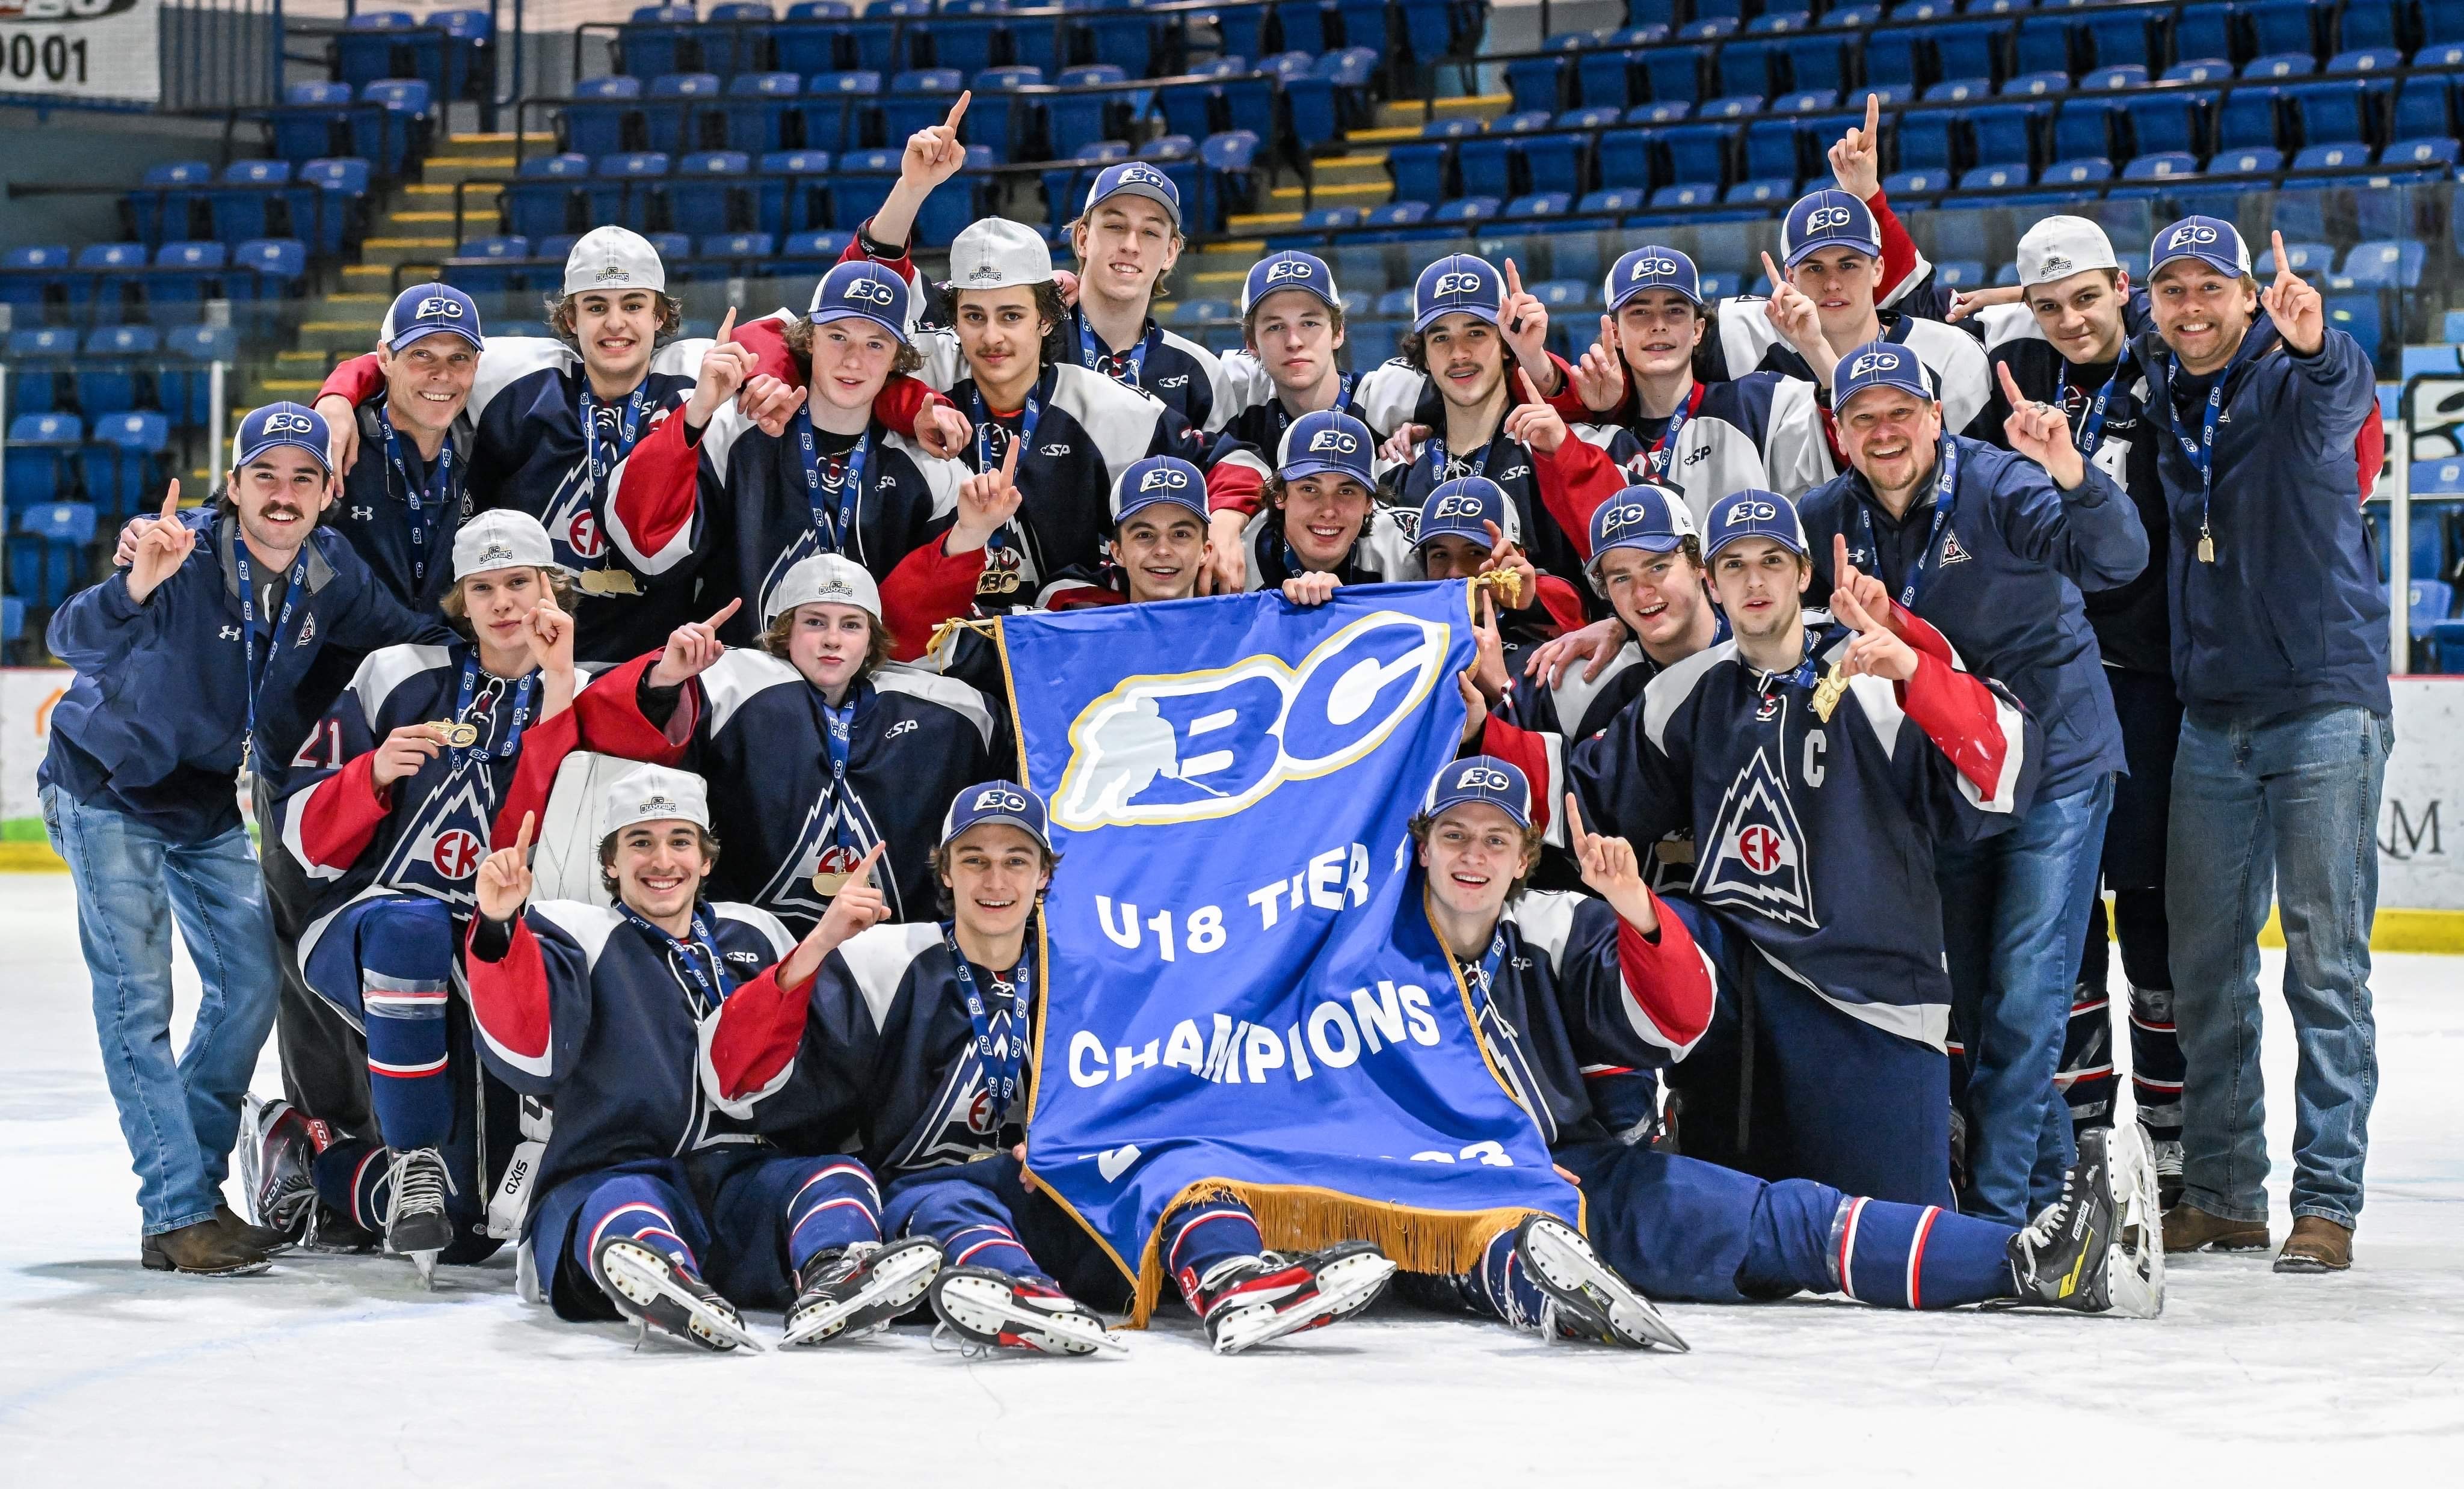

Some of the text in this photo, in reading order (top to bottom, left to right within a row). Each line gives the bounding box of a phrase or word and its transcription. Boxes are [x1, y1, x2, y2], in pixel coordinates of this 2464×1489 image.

[0, 33, 87, 84] 001
[1123, 168, 1163, 188] BC
[1811, 207, 1850, 233] BC
[2174, 226, 2216, 247] BC
[596, 272, 629, 282] CHAMPIONS
[970, 272, 1001, 281] CHAMPIONS
[1272, 261, 1311, 281] BC
[1636, 258, 1676, 279] BC
[2040, 260, 2072, 277] CHAMPIONS
[849, 279, 893, 305] BC
[1440, 273, 1480, 296] BC
[420, 298, 463, 319] BC
[1085, 349, 1094, 367] BC
[1856, 354, 1899, 378] BC
[1342, 379, 1351, 392] BC
[581, 393, 590, 405] BC
[633, 391, 642, 408] BC
[2096, 397, 2104, 414] BC
[2210, 388, 2220, 406] BC
[268, 413, 312, 432] BC
[1672, 415, 1681, 431] BC
[382, 424, 393, 440] BC
[625, 424, 635, 442] BC
[1021, 430, 1030, 449] BC
[2205, 426, 2213, 446] BC
[802, 433, 812, 450] BC
[856, 436, 866, 452] BC
[1314, 431, 1357, 453] BC
[1435, 438, 1443, 450] BC
[1946, 443, 1954, 458] BC
[2084, 432, 2093, 451] BC
[2182, 438, 2197, 452] BC
[442, 449, 451, 467] BC
[1662, 448, 1670, 465] BC
[592, 459, 600, 476] BC
[1434, 465, 1441, 480] BC
[1473, 461, 1482, 476] BC
[807, 470, 818, 488] BC
[848, 470, 858, 489] BC
[1145, 470, 1187, 491] BC
[1943, 475, 1951, 493] BC
[409, 491, 420, 509] BC
[1440, 497, 1482, 517] BC
[813, 509, 824, 526] BC
[840, 508, 849, 527] BC
[1606, 504, 1644, 535] BC
[1731, 502, 1775, 524] BC
[1935, 512, 1944, 529] BC
[413, 527, 422, 544] BC
[479, 550, 513, 564] CHAMPIONS
[239, 560, 249, 580] BC
[294, 564, 304, 585] BC
[416, 562, 424, 578] BC
[819, 586, 852, 597] CHAMPIONS
[983, 572, 1020, 593] BC
[1903, 587, 1914, 606] BC
[244, 601, 252, 621] BC
[282, 602, 291, 623] BC
[463, 672, 475, 690] BC
[520, 675, 531, 690] BC
[513, 707, 522, 725] BC
[1089, 613, 1447, 817] BC
[830, 717, 838, 736] BC
[838, 723, 848, 740] BC
[292, 720, 343, 770] 21
[503, 741, 513, 757] BC
[452, 755, 461, 770] BC
[469, 749, 490, 761] BC
[1803, 729, 1826, 787] C
[834, 760, 842, 778] BC
[1461, 769, 1509, 790] BC
[640, 803, 676, 814] CHAMPIONS
[979, 790, 1026, 811] BC
[2377, 798, 2444, 859] M
[434, 832, 479, 878] EK
[1740, 827, 1780, 872] EK
[1095, 895, 1227, 962] U18
[1248, 843, 1370, 932] TIER
[694, 921, 707, 936] BC
[1494, 936, 1504, 956] BC
[715, 957, 724, 975] BC
[959, 966, 970, 981] BC
[1018, 968, 1027, 982] BC
[695, 969, 707, 987] BC
[970, 998, 982, 1014] BC
[1017, 998, 1026, 1018] BC
[1070, 980, 1440, 1087] CHAMPIONS
[980, 1036, 991, 1055] BC
[1012, 1036, 1021, 1057] BC
[989, 1077, 997, 1096] BC
[1003, 1077, 1013, 1098] BC
[264, 1177, 281, 1208] CCM
